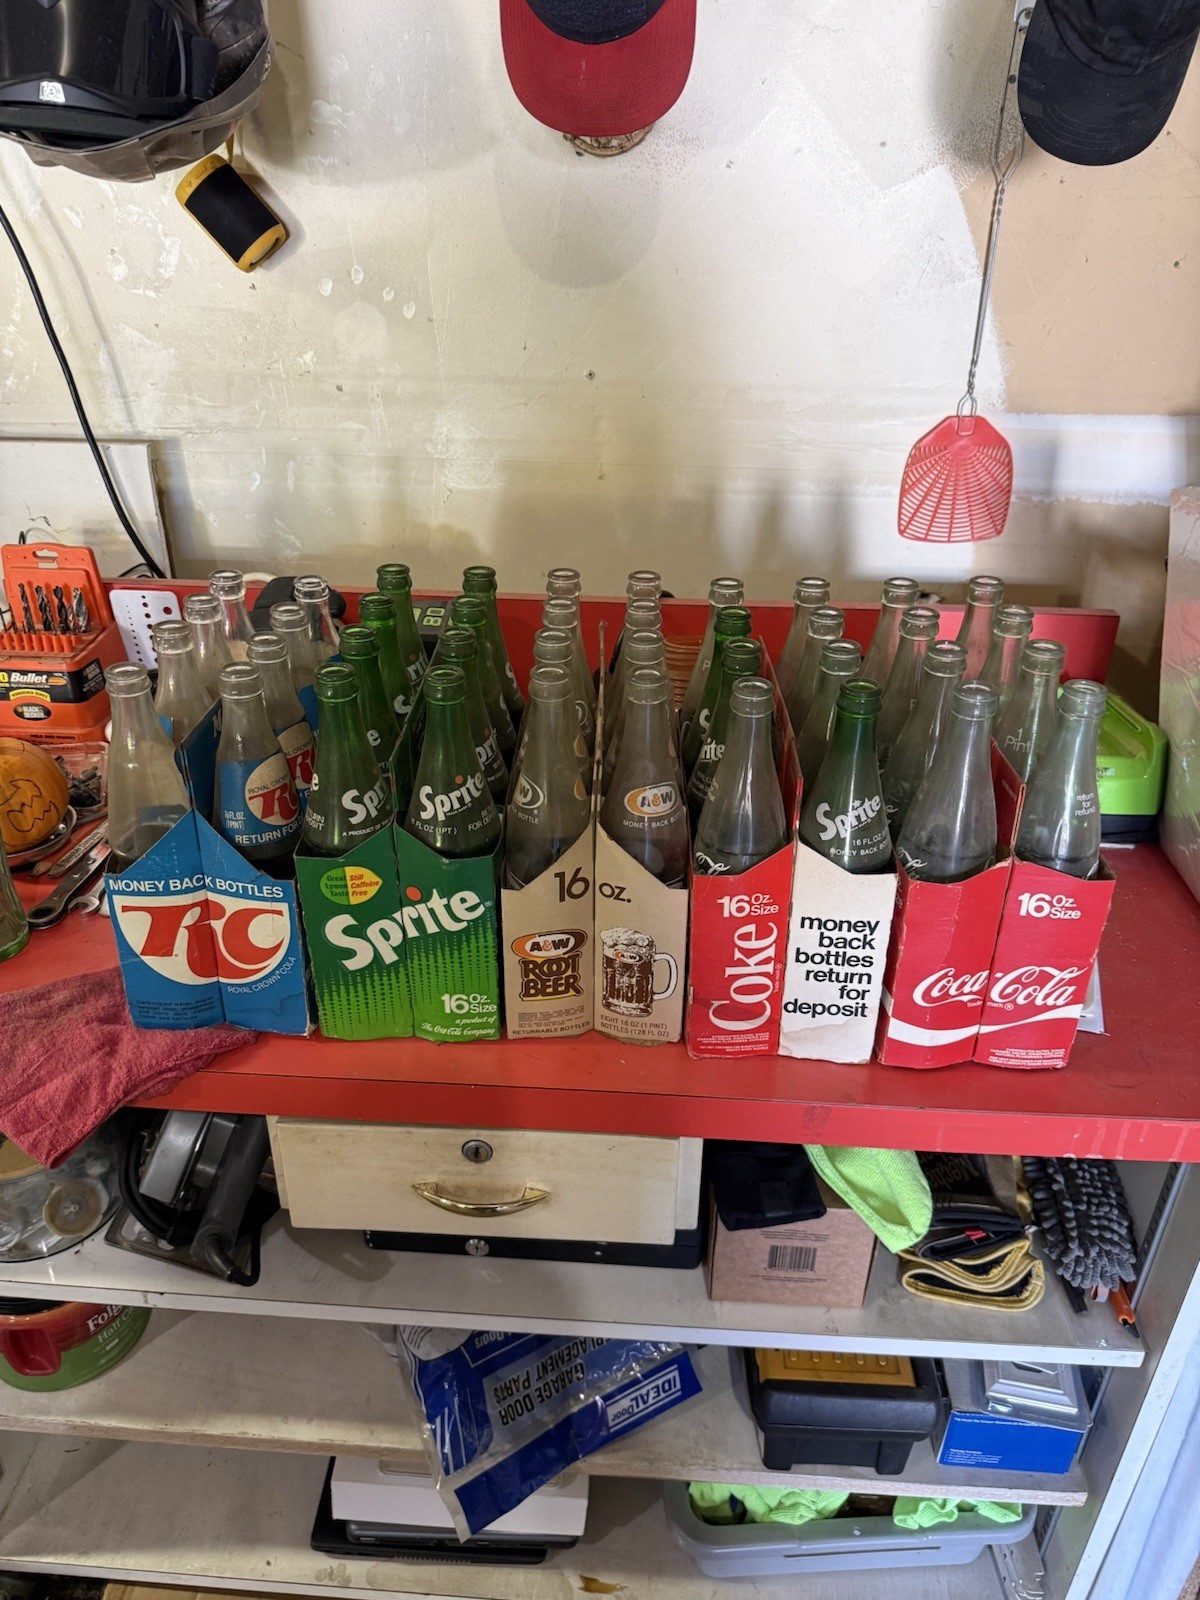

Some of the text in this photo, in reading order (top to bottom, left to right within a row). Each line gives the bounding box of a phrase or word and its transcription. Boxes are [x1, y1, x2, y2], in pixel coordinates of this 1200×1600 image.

[10, 672, 48, 684] Bullet
[1005, 735, 1031, 752] Pint
[248, 783, 271, 795] ROYAL
[419, 772, 485, 821] Sprite
[640, 790, 674, 808] A&W
[623, 819, 648, 829] MONEY
[652, 819, 669, 829] BACK
[815, 795, 882, 842] Sprite
[235, 829, 281, 844] RETURN
[860, 846, 878, 857] BACK
[109, 874, 284, 898] MONEY BACK BOTTLES
[351, 881, 380, 889] Caffeine
[554, 867, 590, 902] 16
[717, 893, 773, 918] 16 Oz.
[751, 904, 780, 916] Size
[1018, 892, 1076, 918] 16 Oz.
[1050, 907, 1081, 919] Size
[324, 886, 486, 971] Sprite
[800, 915, 880, 935] money
[121, 898, 286, 979] RC
[529, 937, 571, 952] A&W
[818, 932, 876, 950] back
[522, 953, 580, 979] ROOT
[794, 949, 874, 967] bottles
[228, 985, 252, 995] ROYAL
[279, 956, 297, 976] COLA
[709, 921, 779, 1031] Coke
[805, 968, 872, 985] return
[523, 974, 582, 998] BEER
[838, 985, 870, 1000] for
[441, 993, 491, 1014] 16 Oz.
[470, 1003, 497, 1013] Size
[783, 998, 868, 1018] deposit
[463, 1027, 495, 1036] Company
[512, 1027, 558, 1035] RETURNABLE
[560, 1021, 590, 1033] BOTTLES
[600, 1015, 619, 1025] EIGHT
[621, 1019, 629, 1027] 16
[630, 1020, 639, 1028] OZ
[649, 1021, 668, 1030] PINT)
[600, 1021, 670, 1038] BOTTLES (128 FL OZ)
[98, 1318, 121, 1344] Half
[493, 1371, 531, 1404] PARTS
[499, 1359, 586, 1426] GARAGE DOOR
[611, 1375, 678, 1421] IDEAL Door
